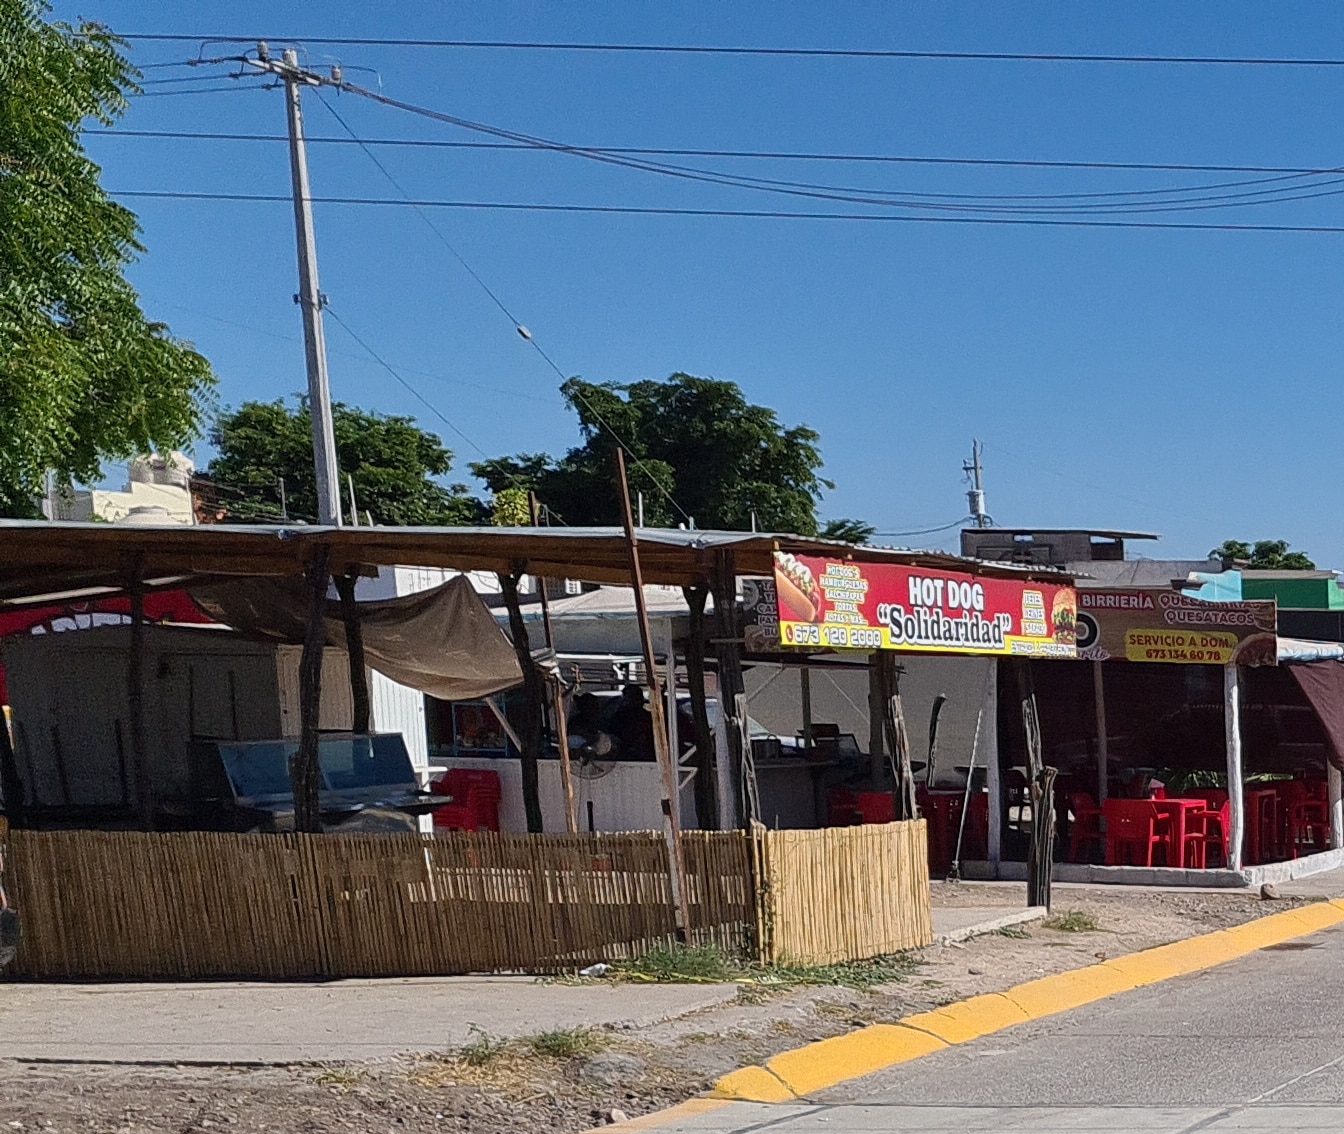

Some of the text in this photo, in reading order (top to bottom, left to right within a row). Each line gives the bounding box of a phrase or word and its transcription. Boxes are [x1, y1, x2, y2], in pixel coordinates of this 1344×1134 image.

[908, 576, 984, 611] HOT DOG
[1082, 593, 1154, 609] BIRRIERÍA
[1164, 610, 1257, 625] QUESATACOS
[794, 625, 881, 647] 673 120 2000
[1129, 634, 1185, 647] SERVICIO
[1189, 637, 1197, 647] A
[1145, 649, 1166, 660] 673
[1189, 651, 1206, 661] 60
